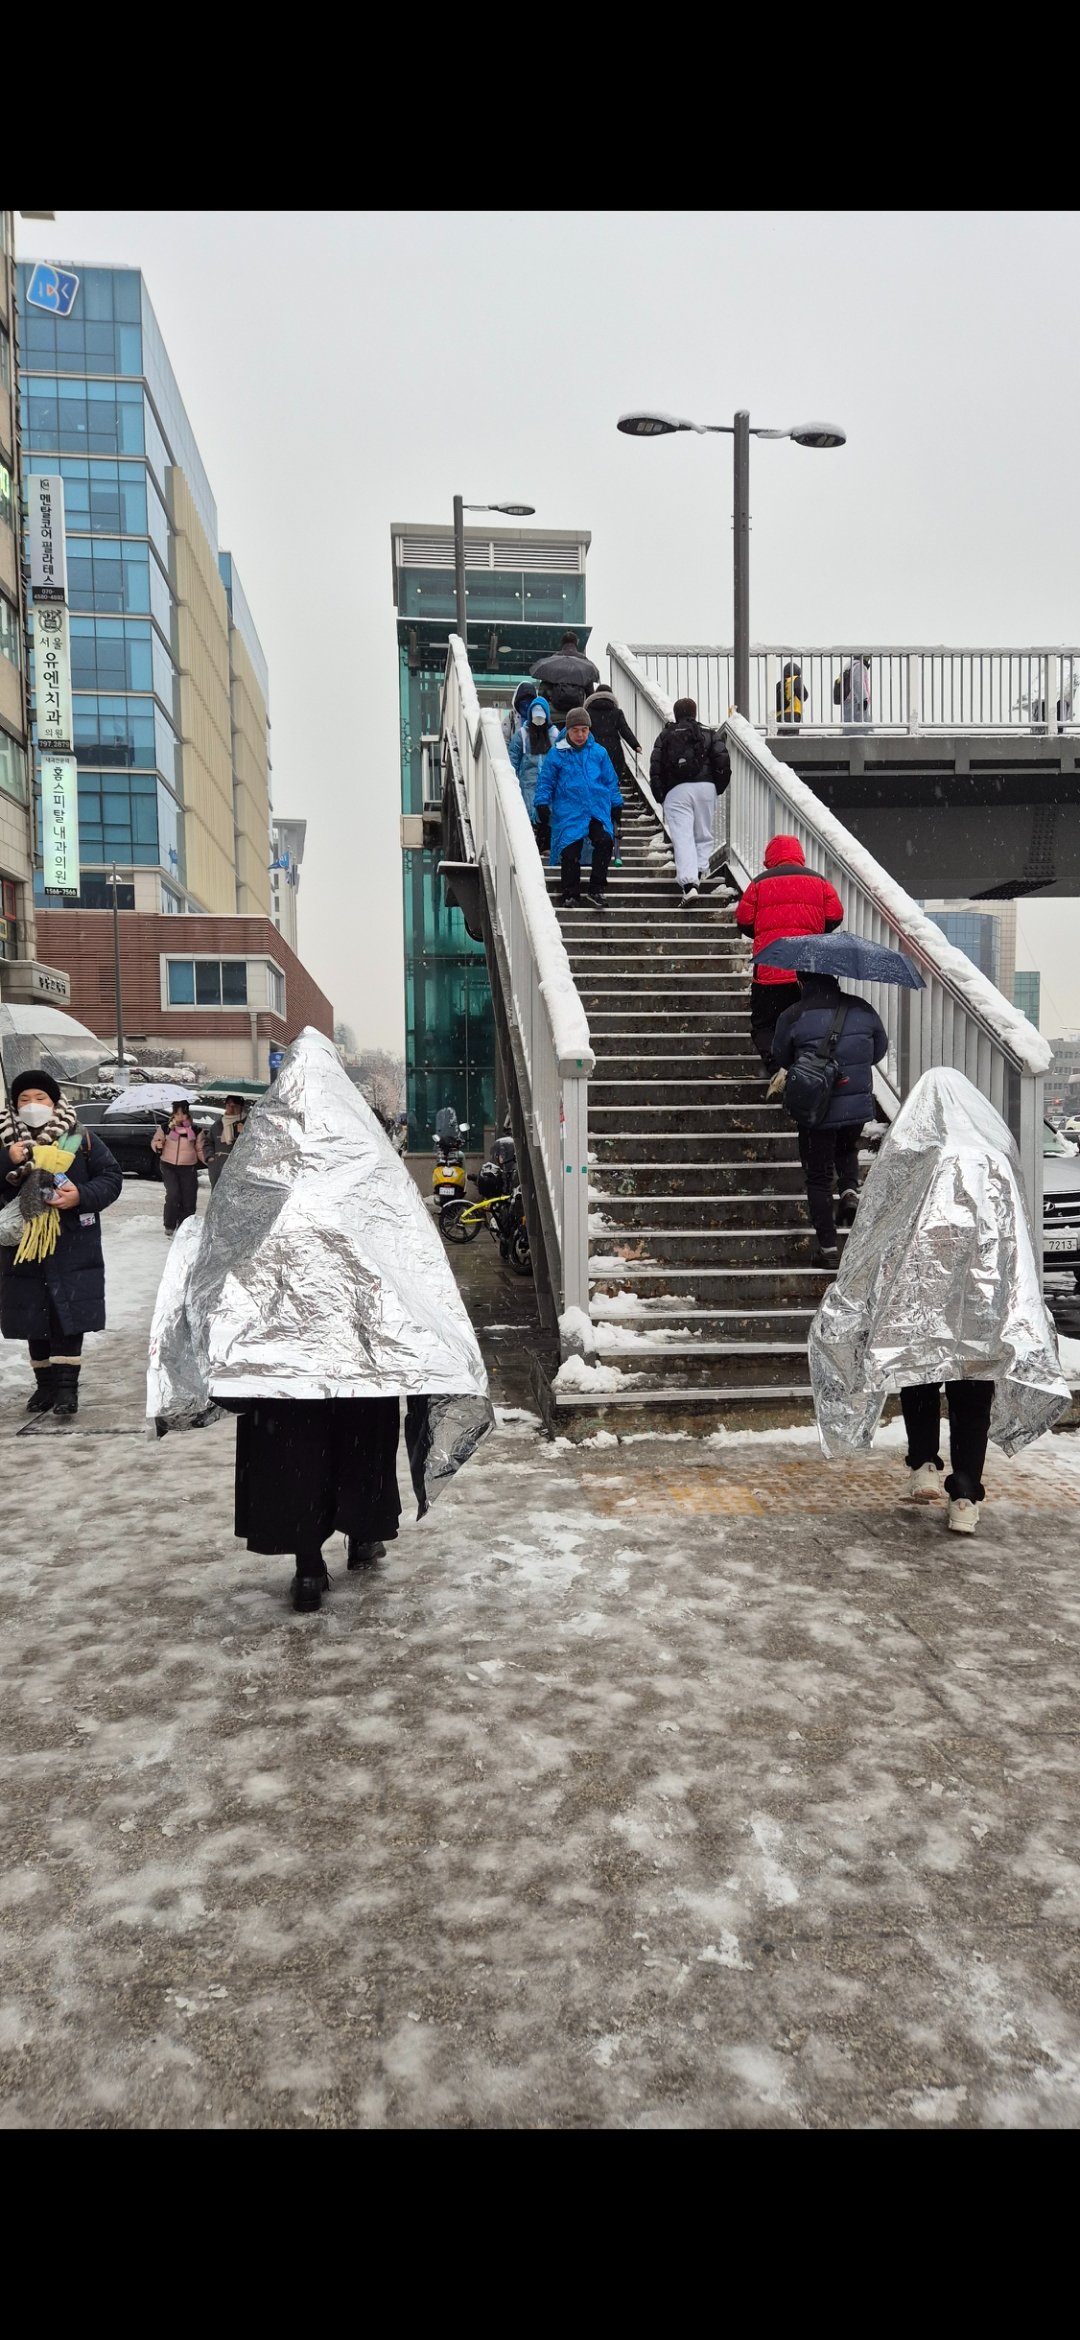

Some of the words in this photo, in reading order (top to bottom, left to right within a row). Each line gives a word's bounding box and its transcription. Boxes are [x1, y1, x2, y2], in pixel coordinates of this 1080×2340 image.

[40, 494, 52, 539] 멘탈코어
[42, 541, 54, 585] 필라테스
[40, 637, 62, 650] 서울
[43, 653, 62, 726] 유엔치과
[45, 729, 63, 738] 의원
[1048, 1240, 1073, 1250] 7213
